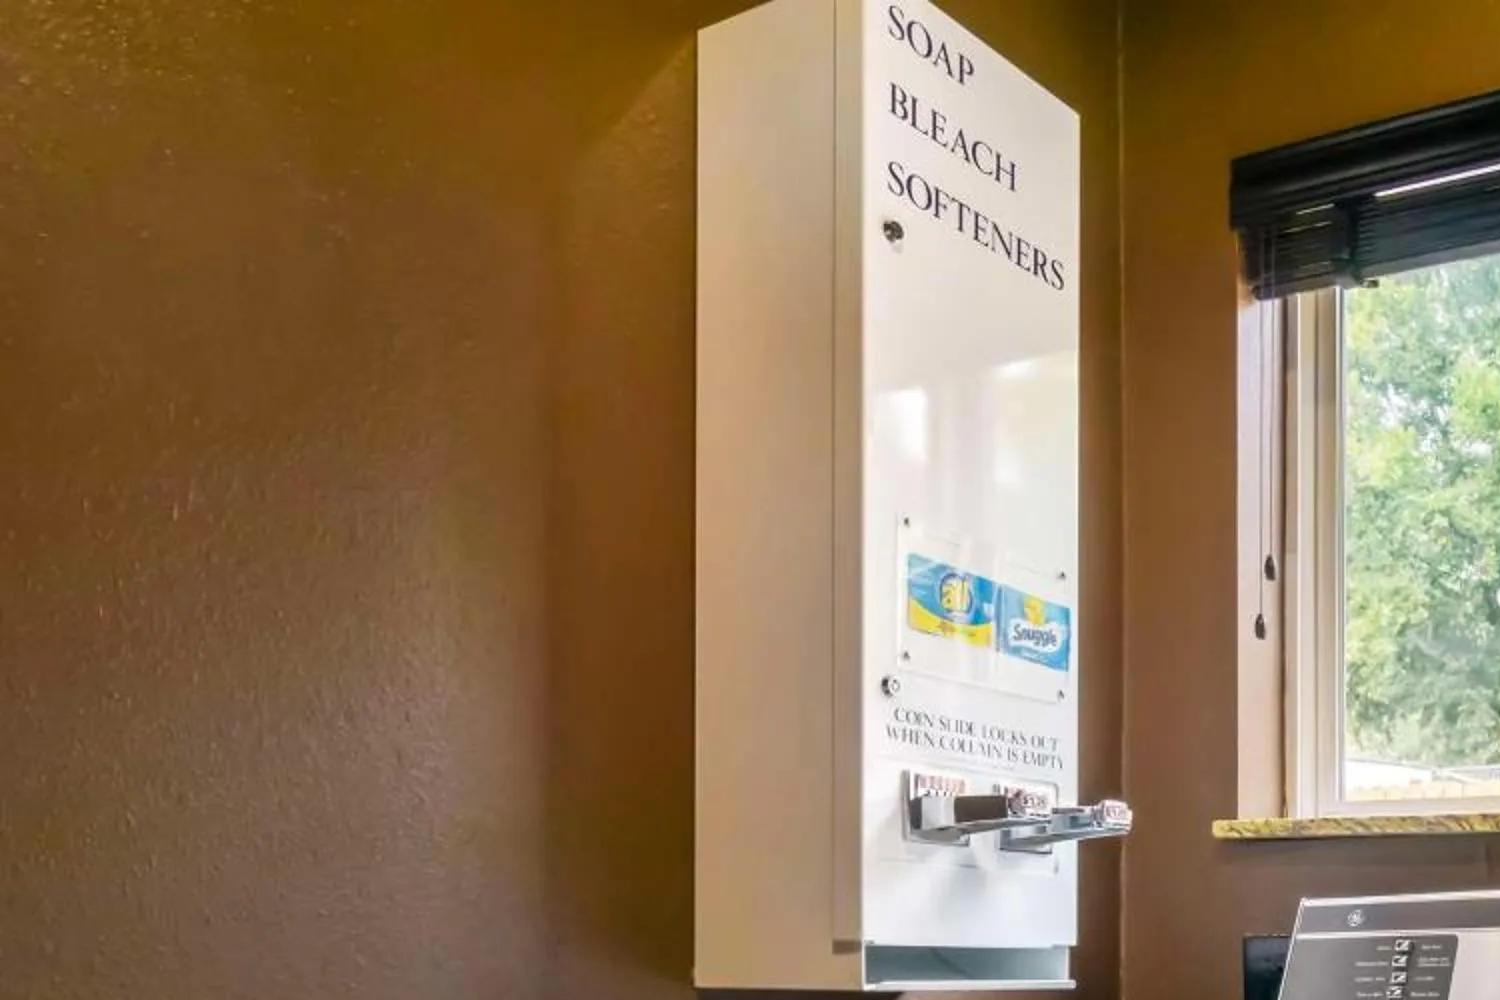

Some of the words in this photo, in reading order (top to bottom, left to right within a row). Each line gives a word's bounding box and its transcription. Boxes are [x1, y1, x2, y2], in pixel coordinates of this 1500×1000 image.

[887, 4, 975, 86] SOAP
[888, 81, 1020, 192] BLEACH
[886, 160, 1066, 291] SOFTENERS
[1011, 622, 1058, 648] Snuggle
[885, 723, 936, 748] WHEN
[1006, 747, 1020, 763] IS
[1022, 750, 1064, 771] EMPTY
[893, 706, 934, 728] COIN
[938, 715, 977, 738] SLIDE
[981, 724, 1028, 747] LOCKS
